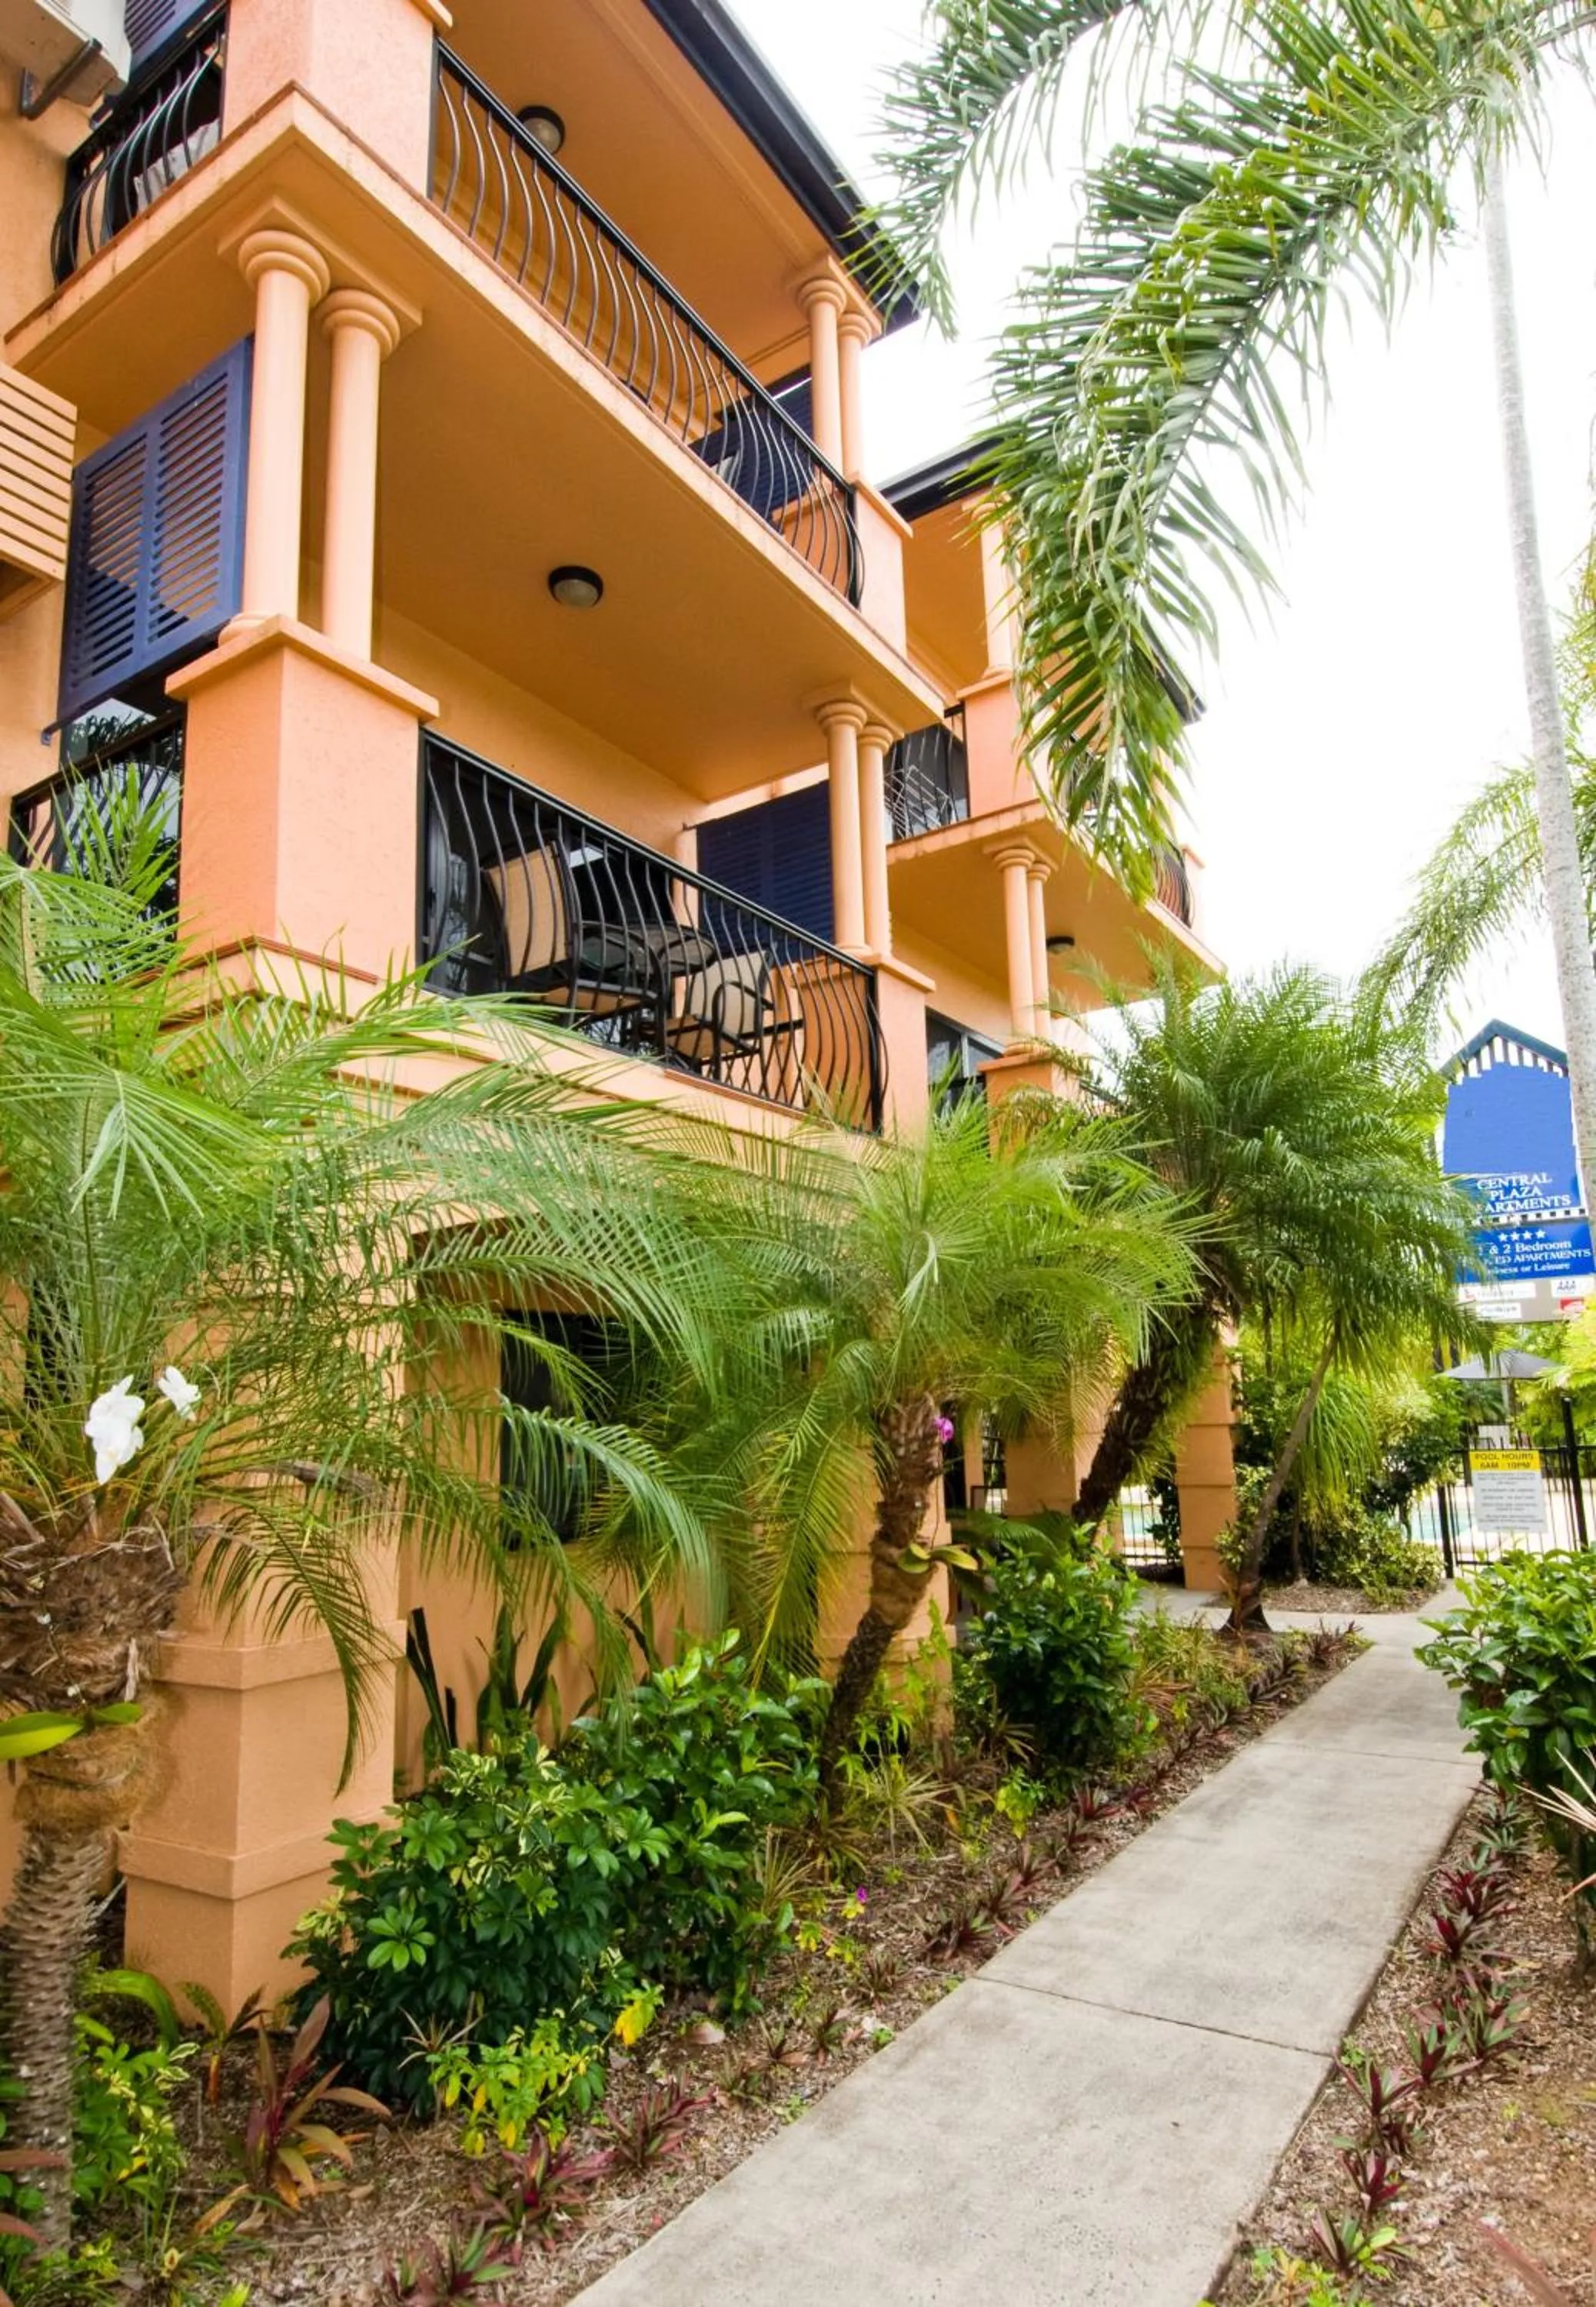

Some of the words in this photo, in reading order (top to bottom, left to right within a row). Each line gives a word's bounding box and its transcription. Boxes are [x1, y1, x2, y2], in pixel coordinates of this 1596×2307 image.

[1476, 1172, 1552, 1190] CENTRAL
[1491, 1186, 1542, 1200] PLAZA
[1485, 1194, 1571, 1213] ARTMENTS
[1488, 1245, 1498, 1255] &
[1503, 1243, 1511, 1254] 2
[1515, 1240, 1572, 1253] Bedroom
[1514, 1248, 1591, 1263] APARTMENTS
[1534, 1262, 1571, 1271] Leisure
